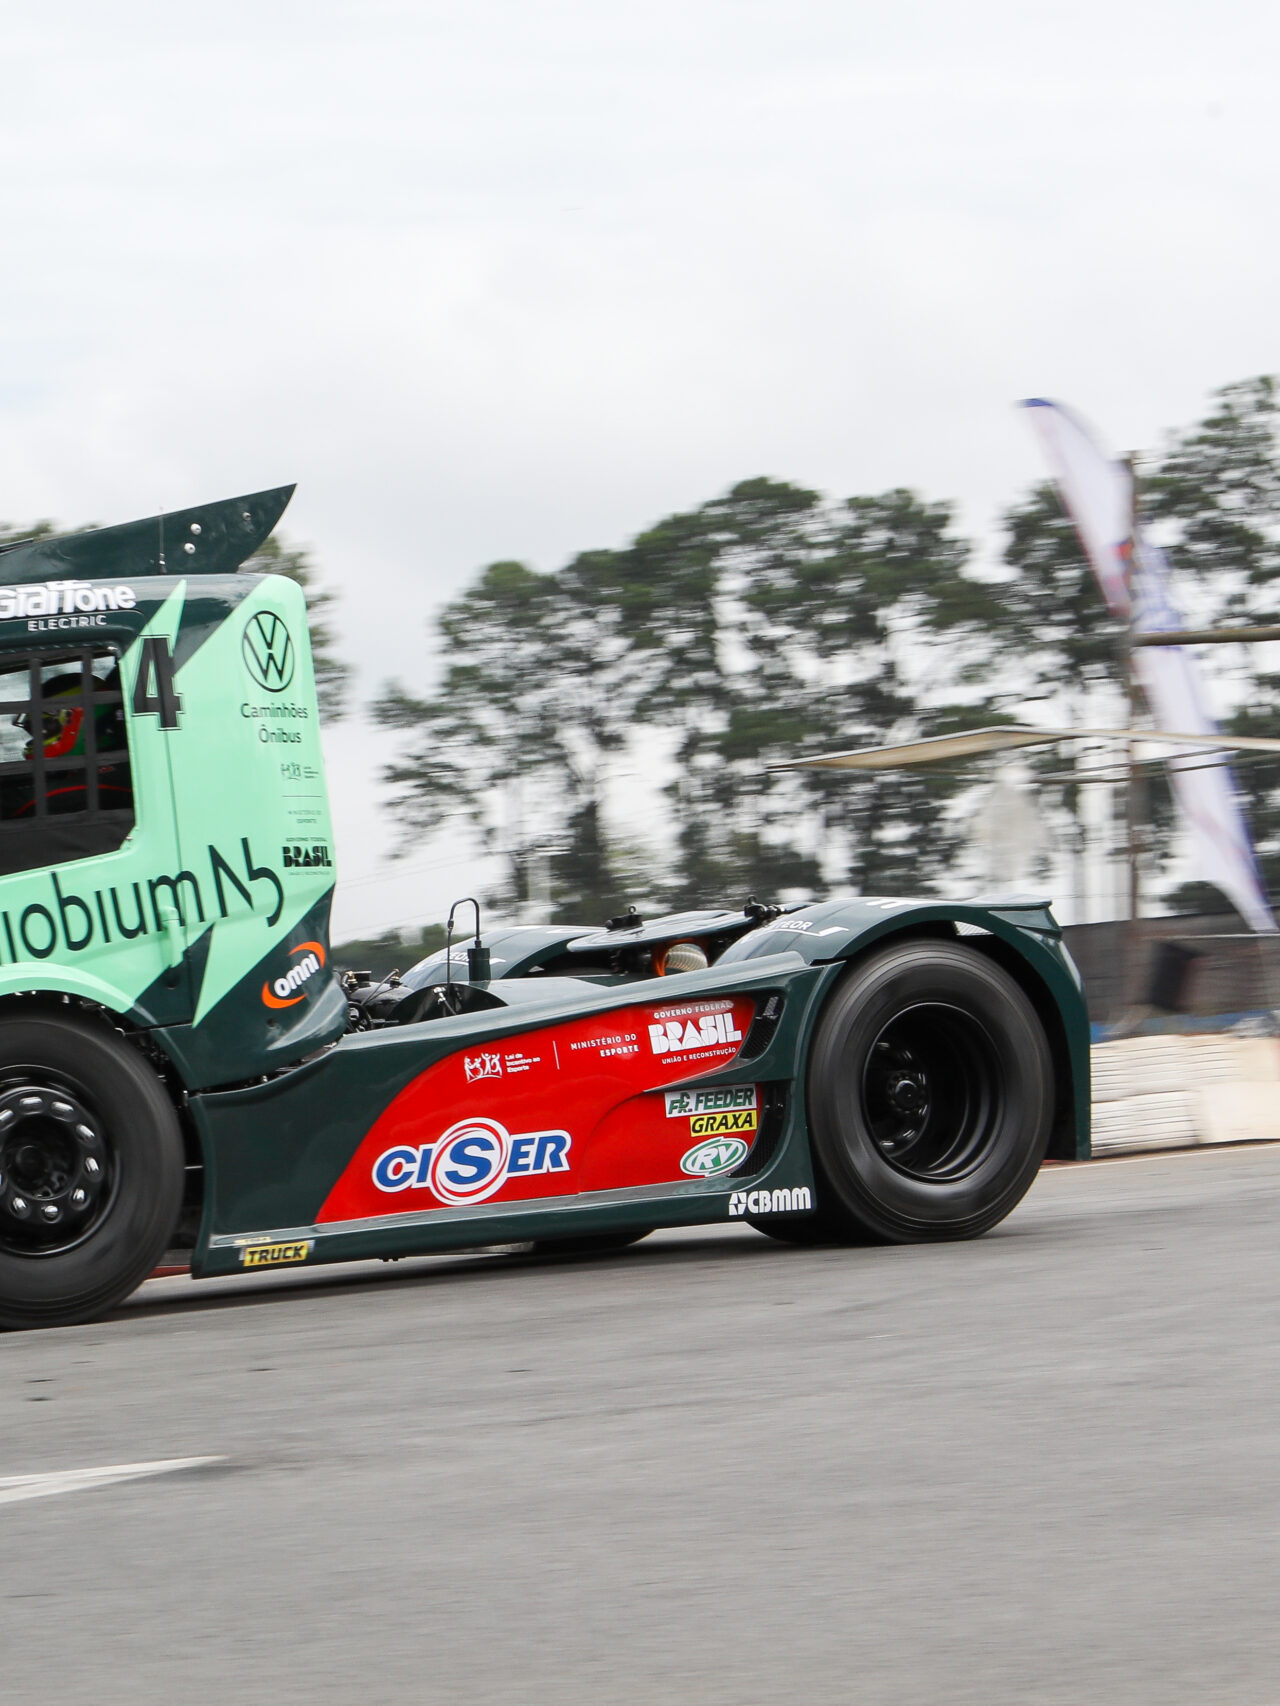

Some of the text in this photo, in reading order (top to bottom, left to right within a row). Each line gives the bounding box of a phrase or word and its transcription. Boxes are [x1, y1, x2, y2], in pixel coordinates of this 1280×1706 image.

[28, 614, 107, 632] ELECTRIC
[133, 634, 186, 731] 4
[240, 702, 309, 719] Caminhões
[258, 723, 302, 743] Ônibus
[282, 845, 332, 868] BRASIL
[274, 953, 320, 997] omni
[654, 1001, 734, 1019] GOVERNO FEDERAL
[571, 1033, 637, 1050] MINISTÉRIO DO
[648, 1012, 742, 1054] BRASIL
[600, 1045, 639, 1057] ESPORTE
[662, 1056, 682, 1064] UNIÃO
[689, 1047, 737, 1060] RECONSTRUÇÃO
[695, 1088, 755, 1111] FEEDER
[692, 1112, 753, 1134] GRAXA
[372, 1128, 571, 1195] CISER
[694, 1142, 740, 1173] RV
[747, 1187, 811, 1214] CBMM
[249, 1245, 304, 1264] TRUCK
